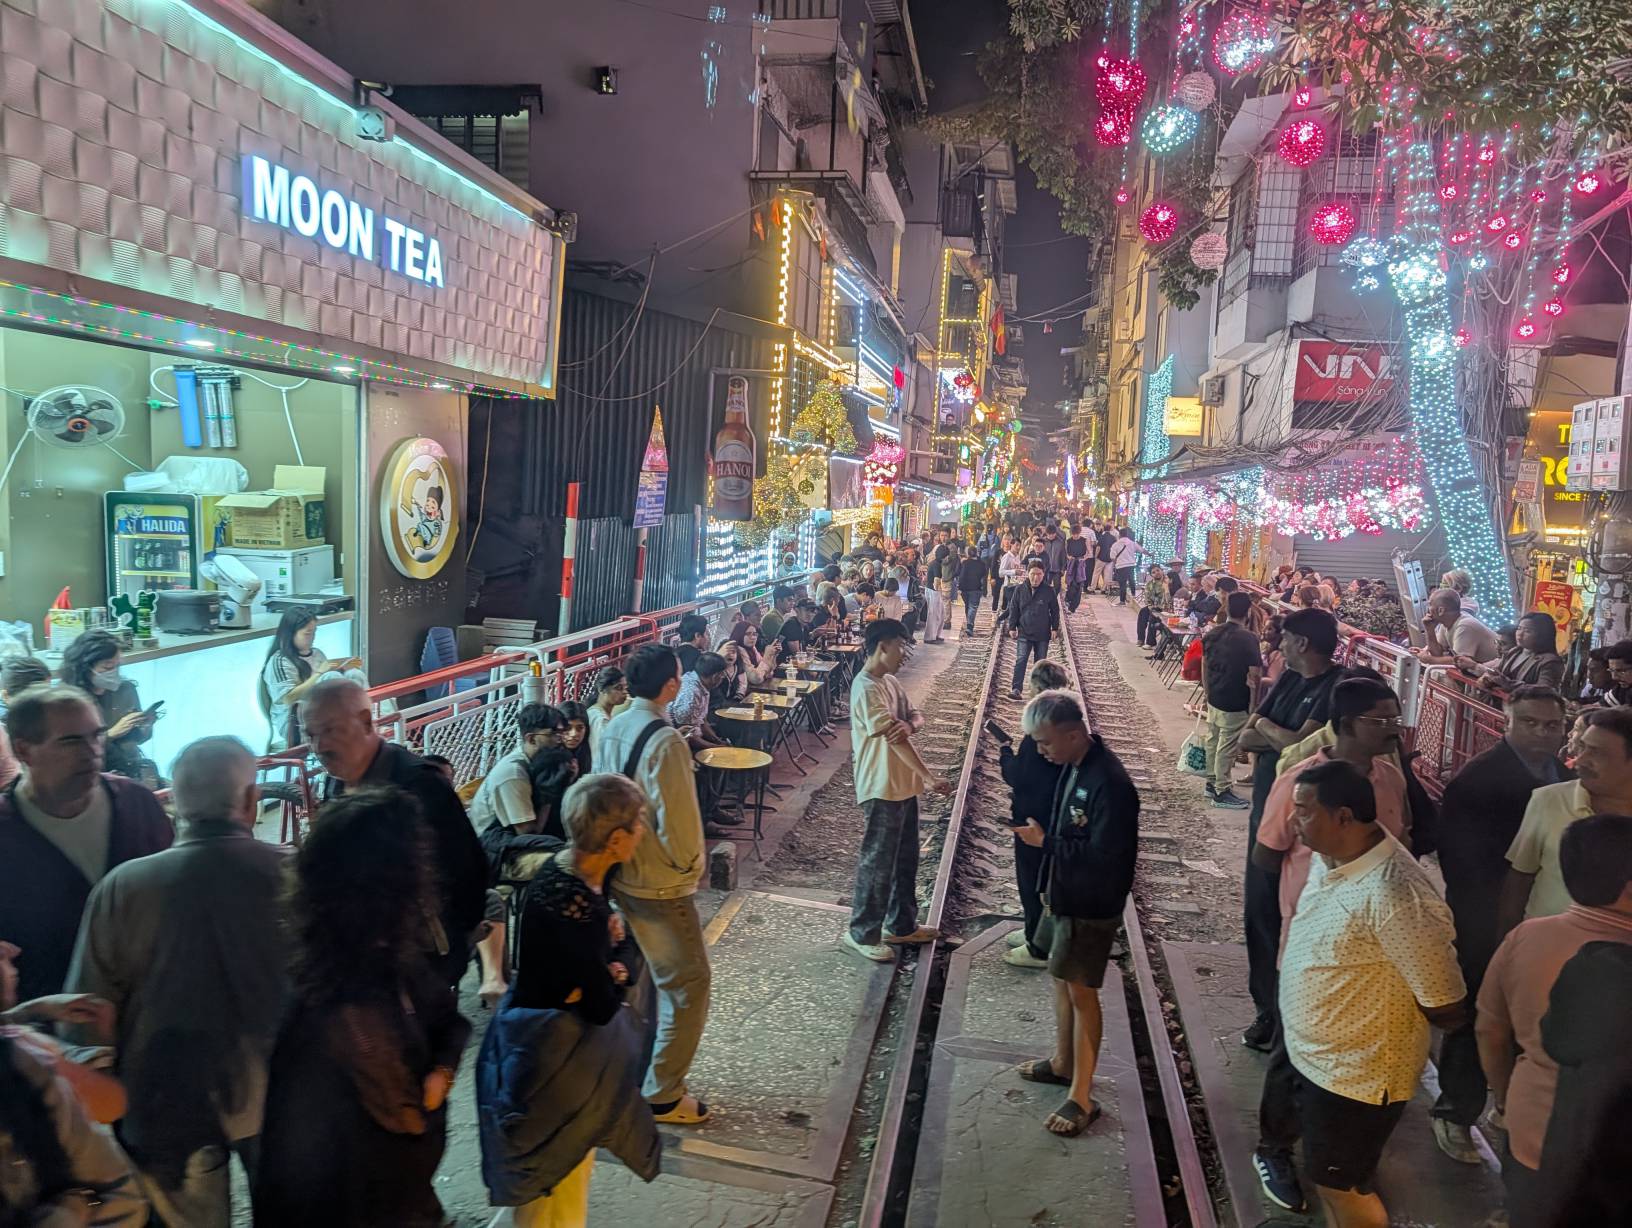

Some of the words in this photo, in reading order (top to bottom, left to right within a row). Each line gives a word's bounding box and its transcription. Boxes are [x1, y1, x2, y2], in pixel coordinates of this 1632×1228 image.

[250, 155, 374, 261] MOON
[384, 217, 444, 288] TEA
[716, 463, 751, 478] HANOI
[1554, 493, 1581, 502] SINCE
[141, 519, 187, 533] HALIDA
